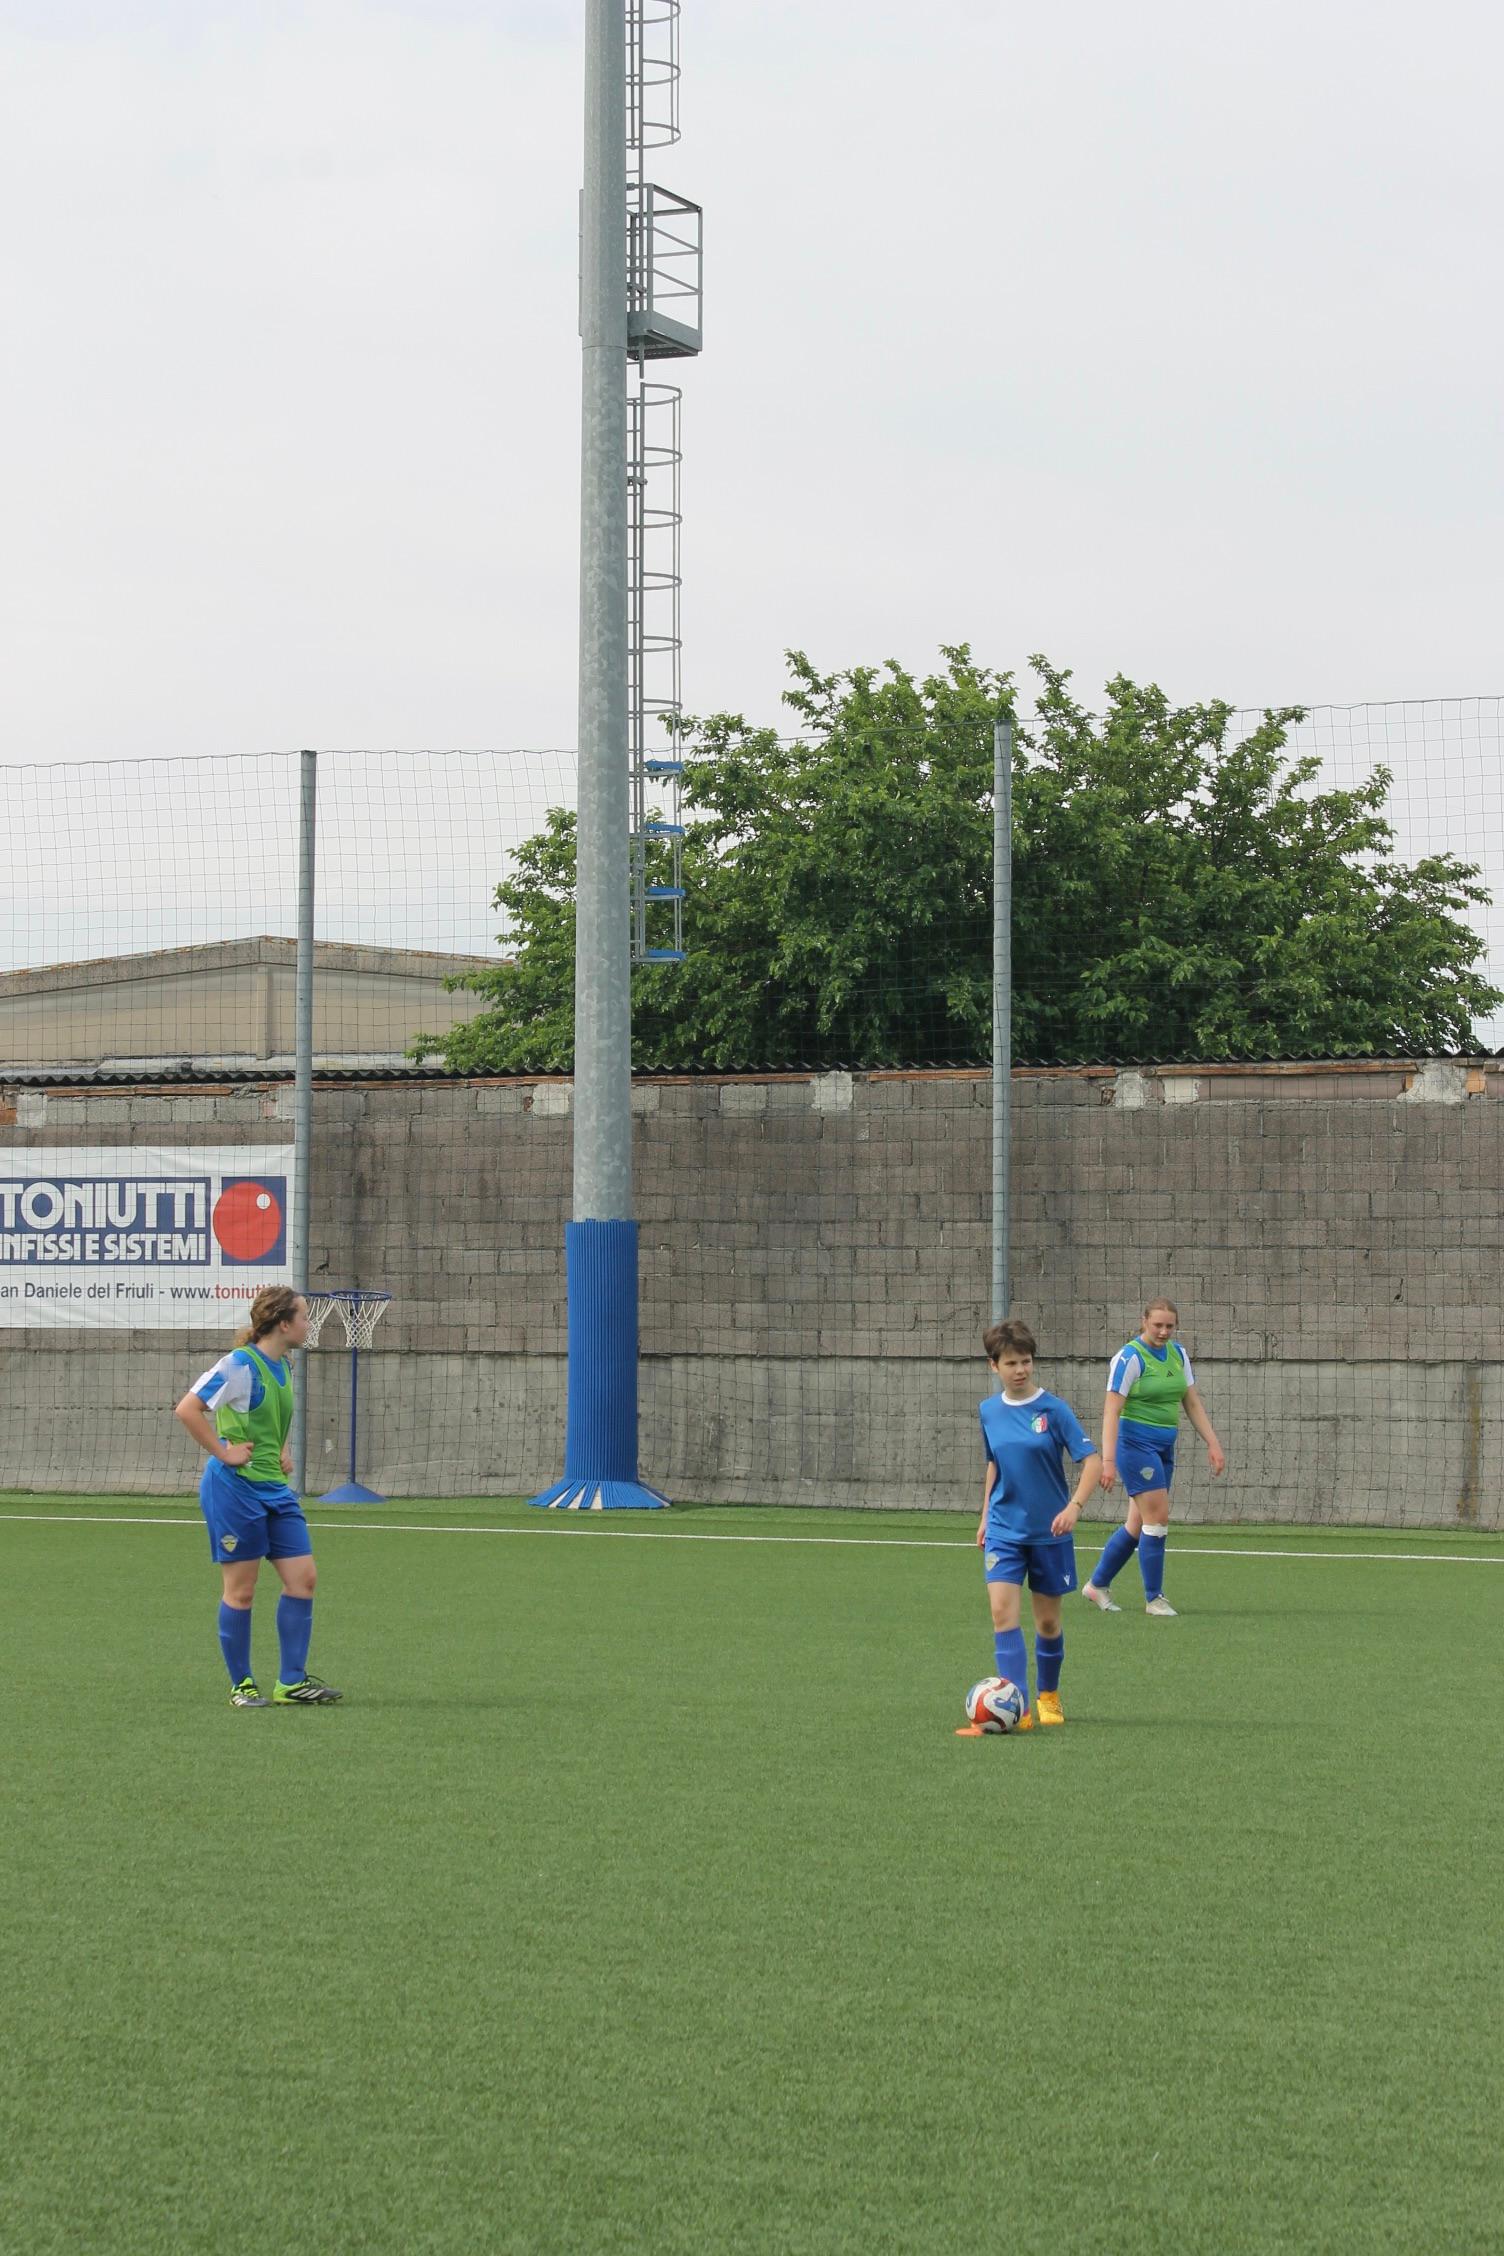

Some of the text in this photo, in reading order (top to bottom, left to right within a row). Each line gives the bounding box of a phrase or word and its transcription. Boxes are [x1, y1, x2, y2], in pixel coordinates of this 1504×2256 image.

[0, 1181, 206, 1230] TONIUTTI
[85, 1233, 100, 1261] E
[104, 1233, 206, 1261] SISTEMI
[24, 1282, 82, 1298] Daniele
[87, 1282, 110, 1299] del
[116, 1283, 154, 1299] Friuli
